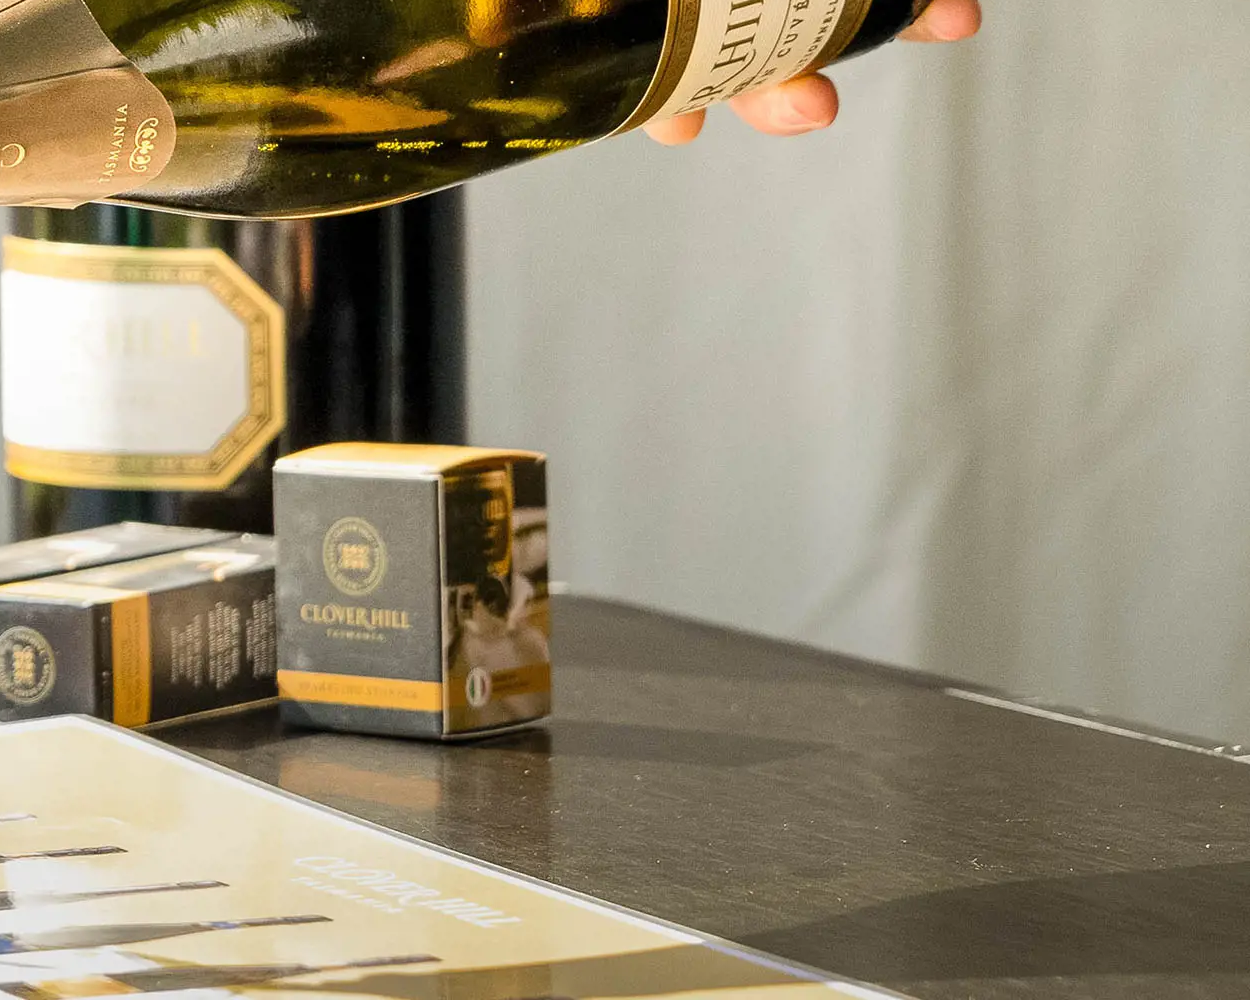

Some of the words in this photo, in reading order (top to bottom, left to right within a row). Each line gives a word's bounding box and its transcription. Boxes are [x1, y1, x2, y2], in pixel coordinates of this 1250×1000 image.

[98, 103, 128, 184] TASMANIA
[301, 603, 376, 630] CLOVER
[372, 608, 413, 629] HILL
[294, 856, 440, 904] CLOVER
[416, 897, 523, 928] HILL
